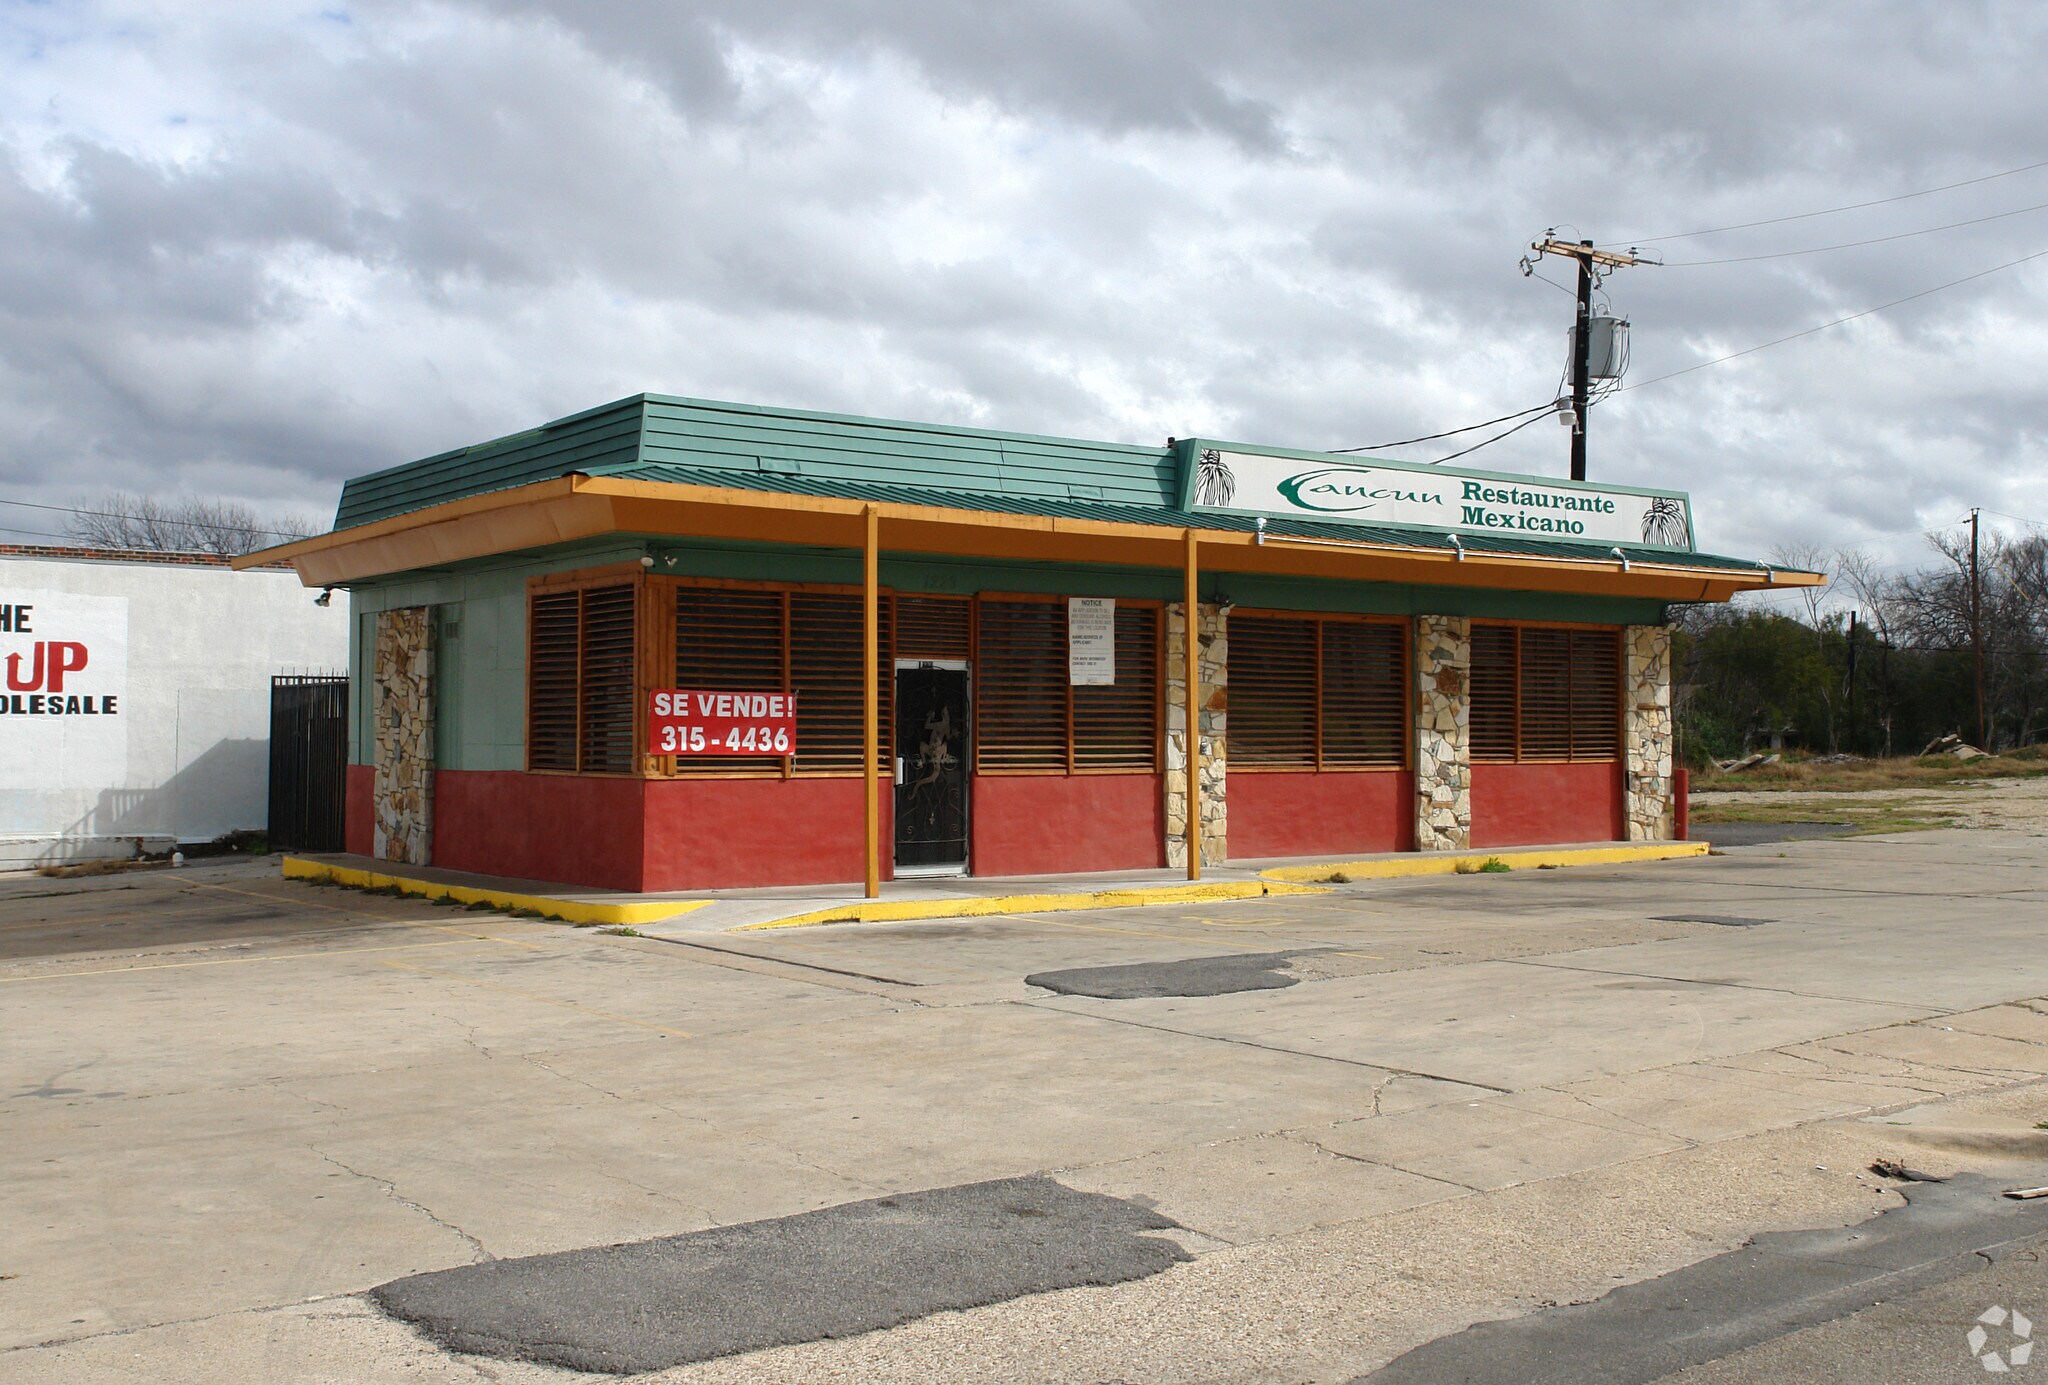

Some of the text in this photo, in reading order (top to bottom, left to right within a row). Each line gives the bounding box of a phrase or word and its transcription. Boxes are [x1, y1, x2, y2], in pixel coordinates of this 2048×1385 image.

[1277, 468, 1443, 512] Cancun
[1461, 480, 1615, 514] Restaurante
[1460, 505, 1584, 535] Mexicano
[4, 640, 88, 693] UP
[654, 692, 793, 718] SE VENDE!
